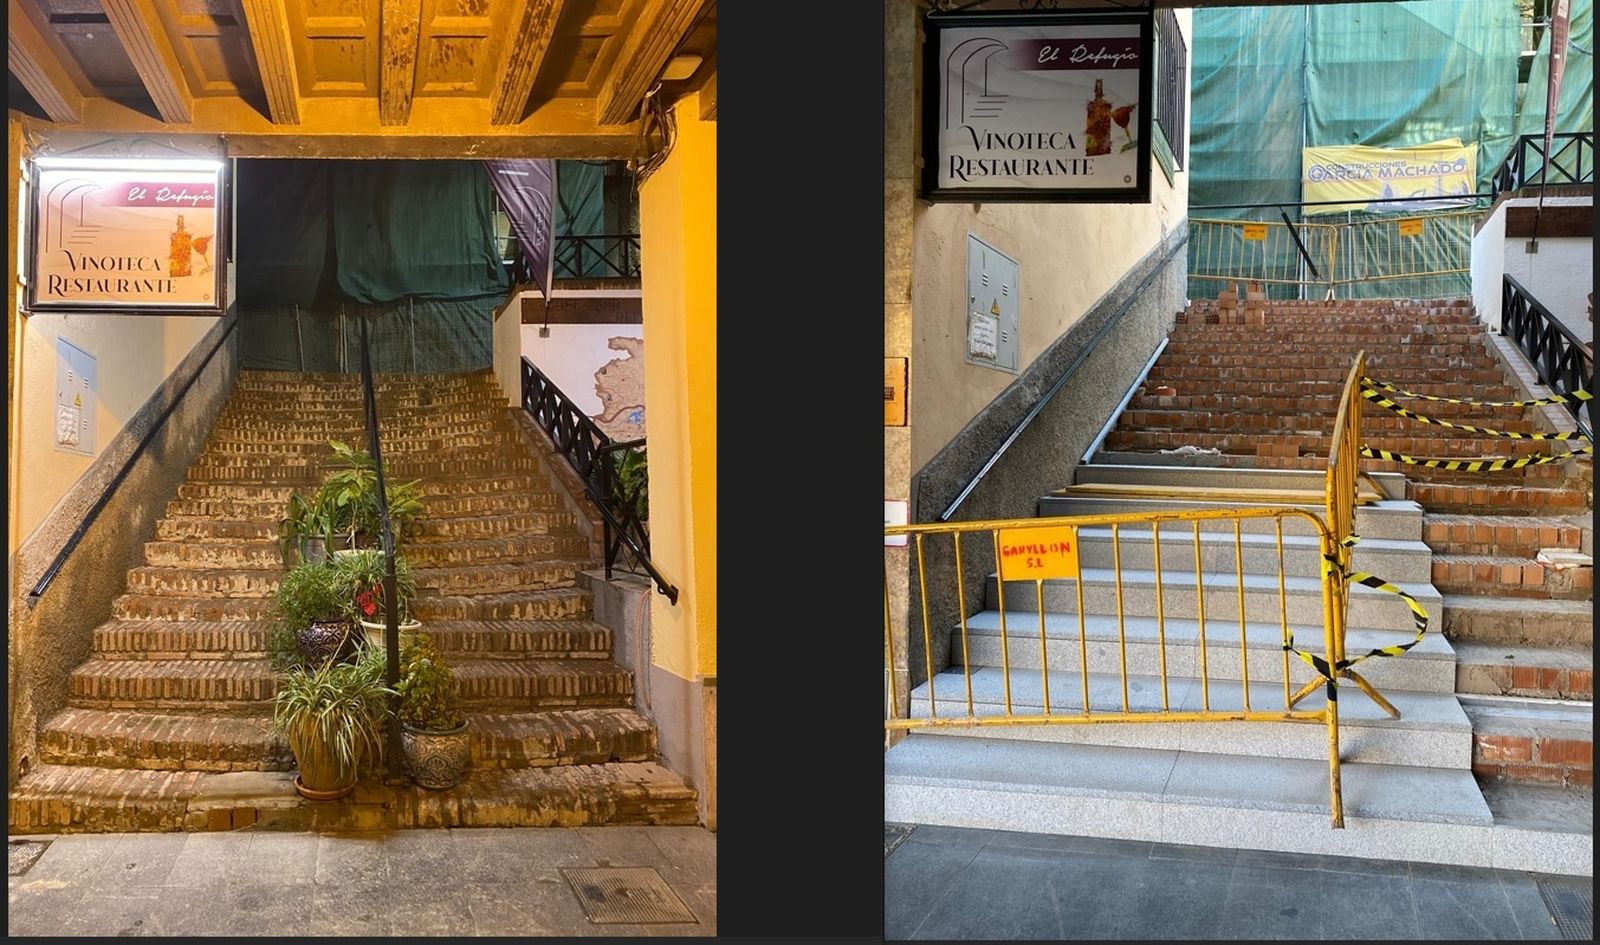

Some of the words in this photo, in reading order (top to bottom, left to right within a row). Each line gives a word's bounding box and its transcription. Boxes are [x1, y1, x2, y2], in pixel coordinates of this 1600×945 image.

[1037, 45, 1059, 63] El
[1071, 44, 1139, 68] Refugio
[961, 125, 1076, 152] VINOTECA
[949, 155, 1095, 182] RESTAURANTE
[1326, 160, 1407, 170] CONSTRUCCIONES
[1378, 162, 1466, 178] MACHADO
[127, 186, 147, 202] El
[155, 187, 215, 206] Refugio
[58, 249, 161, 272] VINOTECA
[47, 274, 177, 297] RESTAURANTE
